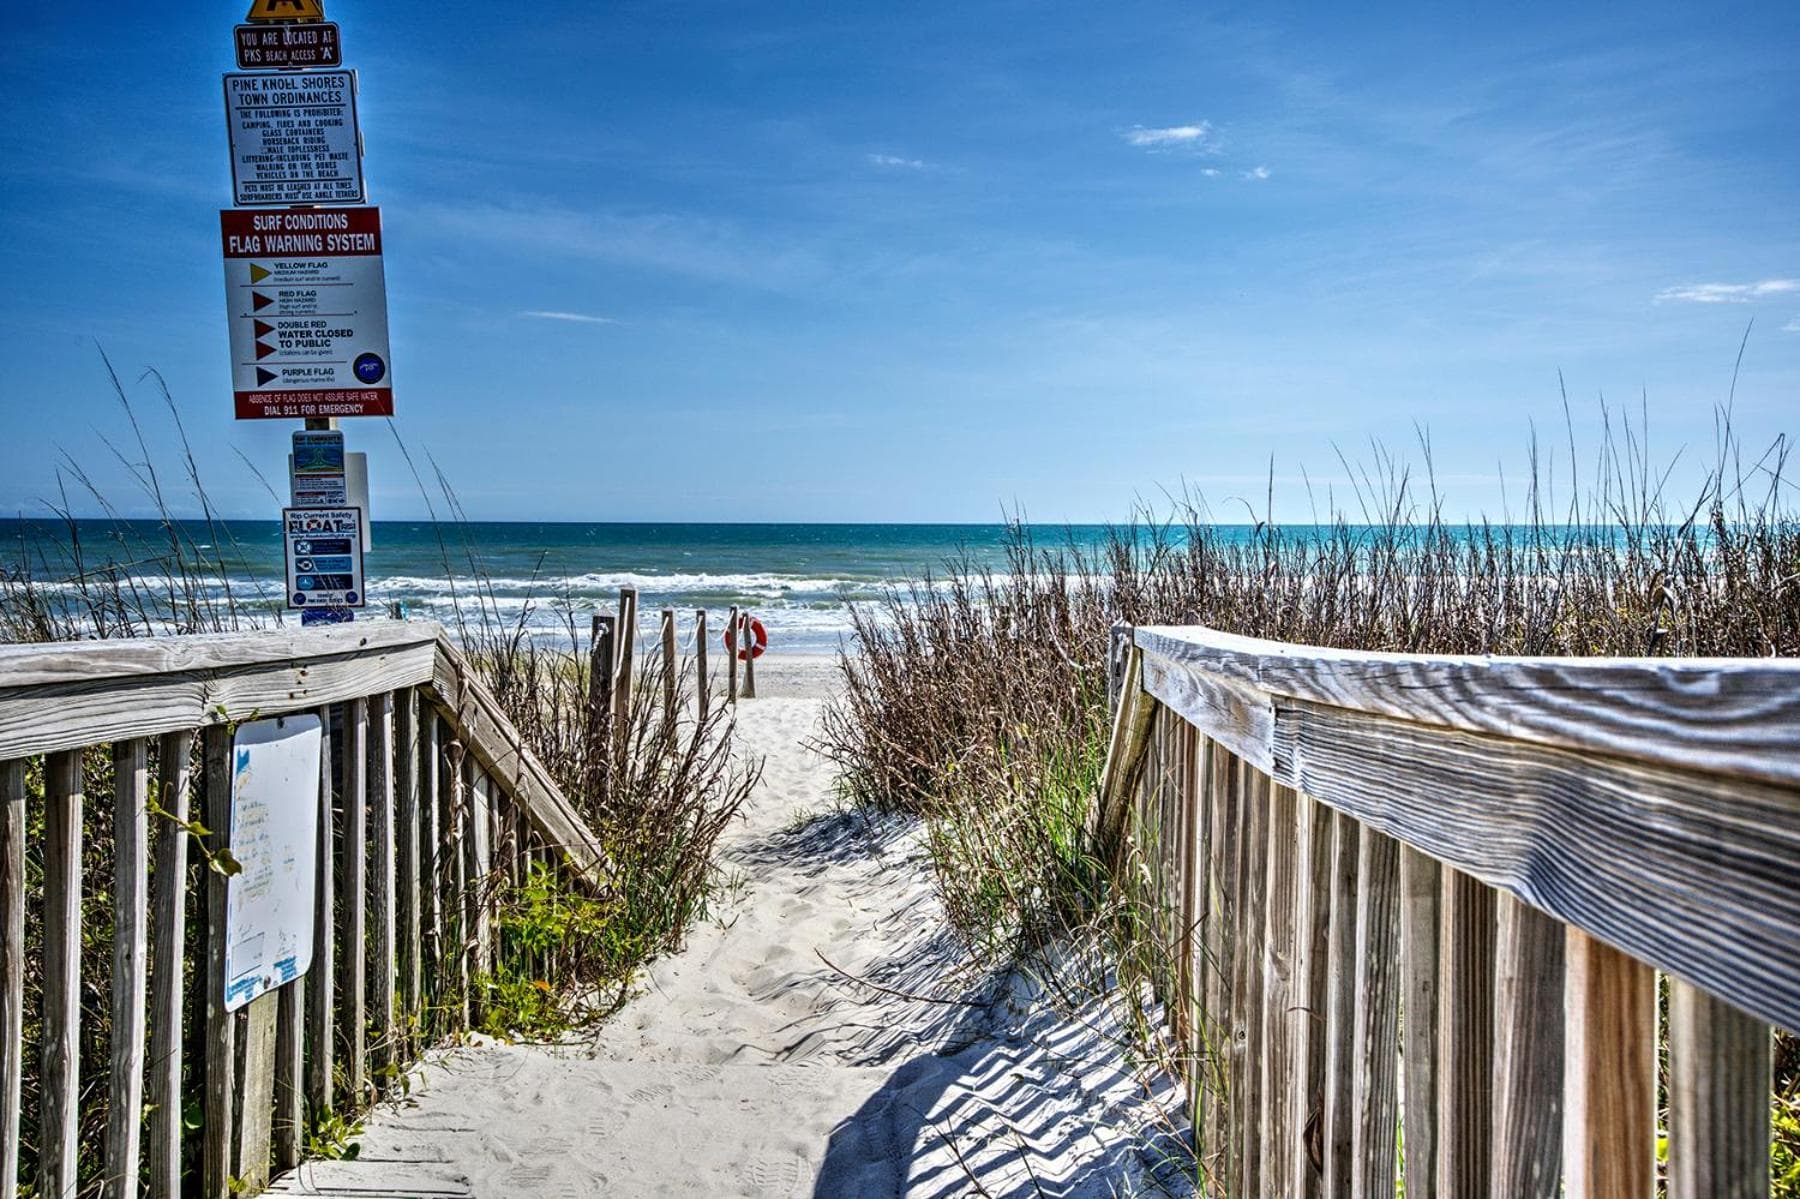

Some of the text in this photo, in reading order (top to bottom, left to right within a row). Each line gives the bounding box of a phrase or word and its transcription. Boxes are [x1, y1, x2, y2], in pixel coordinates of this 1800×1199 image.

[241, 30, 334, 46] YOU ARE LOCATED AT
[244, 49, 261, 62] PKS
[266, 50, 288, 62] BEACH
[291, 50, 316, 61] ACCESS
[232, 76, 345, 91] PINE KNOLL SHORES
[238, 91, 342, 105] TOWN ORDINANCES
[255, 109, 291, 118] FOLLOWING
[298, 119, 311, 128] AND
[315, 118, 343, 127] COOKING
[262, 128, 324, 137] GLASS CONTAINERS
[253, 213, 348, 231] SURF CONDITIONS
[229, 233, 375, 253] FLAG WARNING SYSTEM
[278, 320, 327, 329] DOUBLE RED
[278, 329, 354, 339] WATER CLOSED
[279, 339, 331, 348] TO PUBLIC
[297, 393, 312, 402] DOES
[313, 392, 323, 402] NOT
[325, 392, 345, 401] ASSURE
[346, 391, 360, 401] SAFE
[361, 391, 378, 401] WATER
[264, 403, 364, 415] DIAL 911 FOR EMERGENCY
[331, 511, 352, 519] Safety
